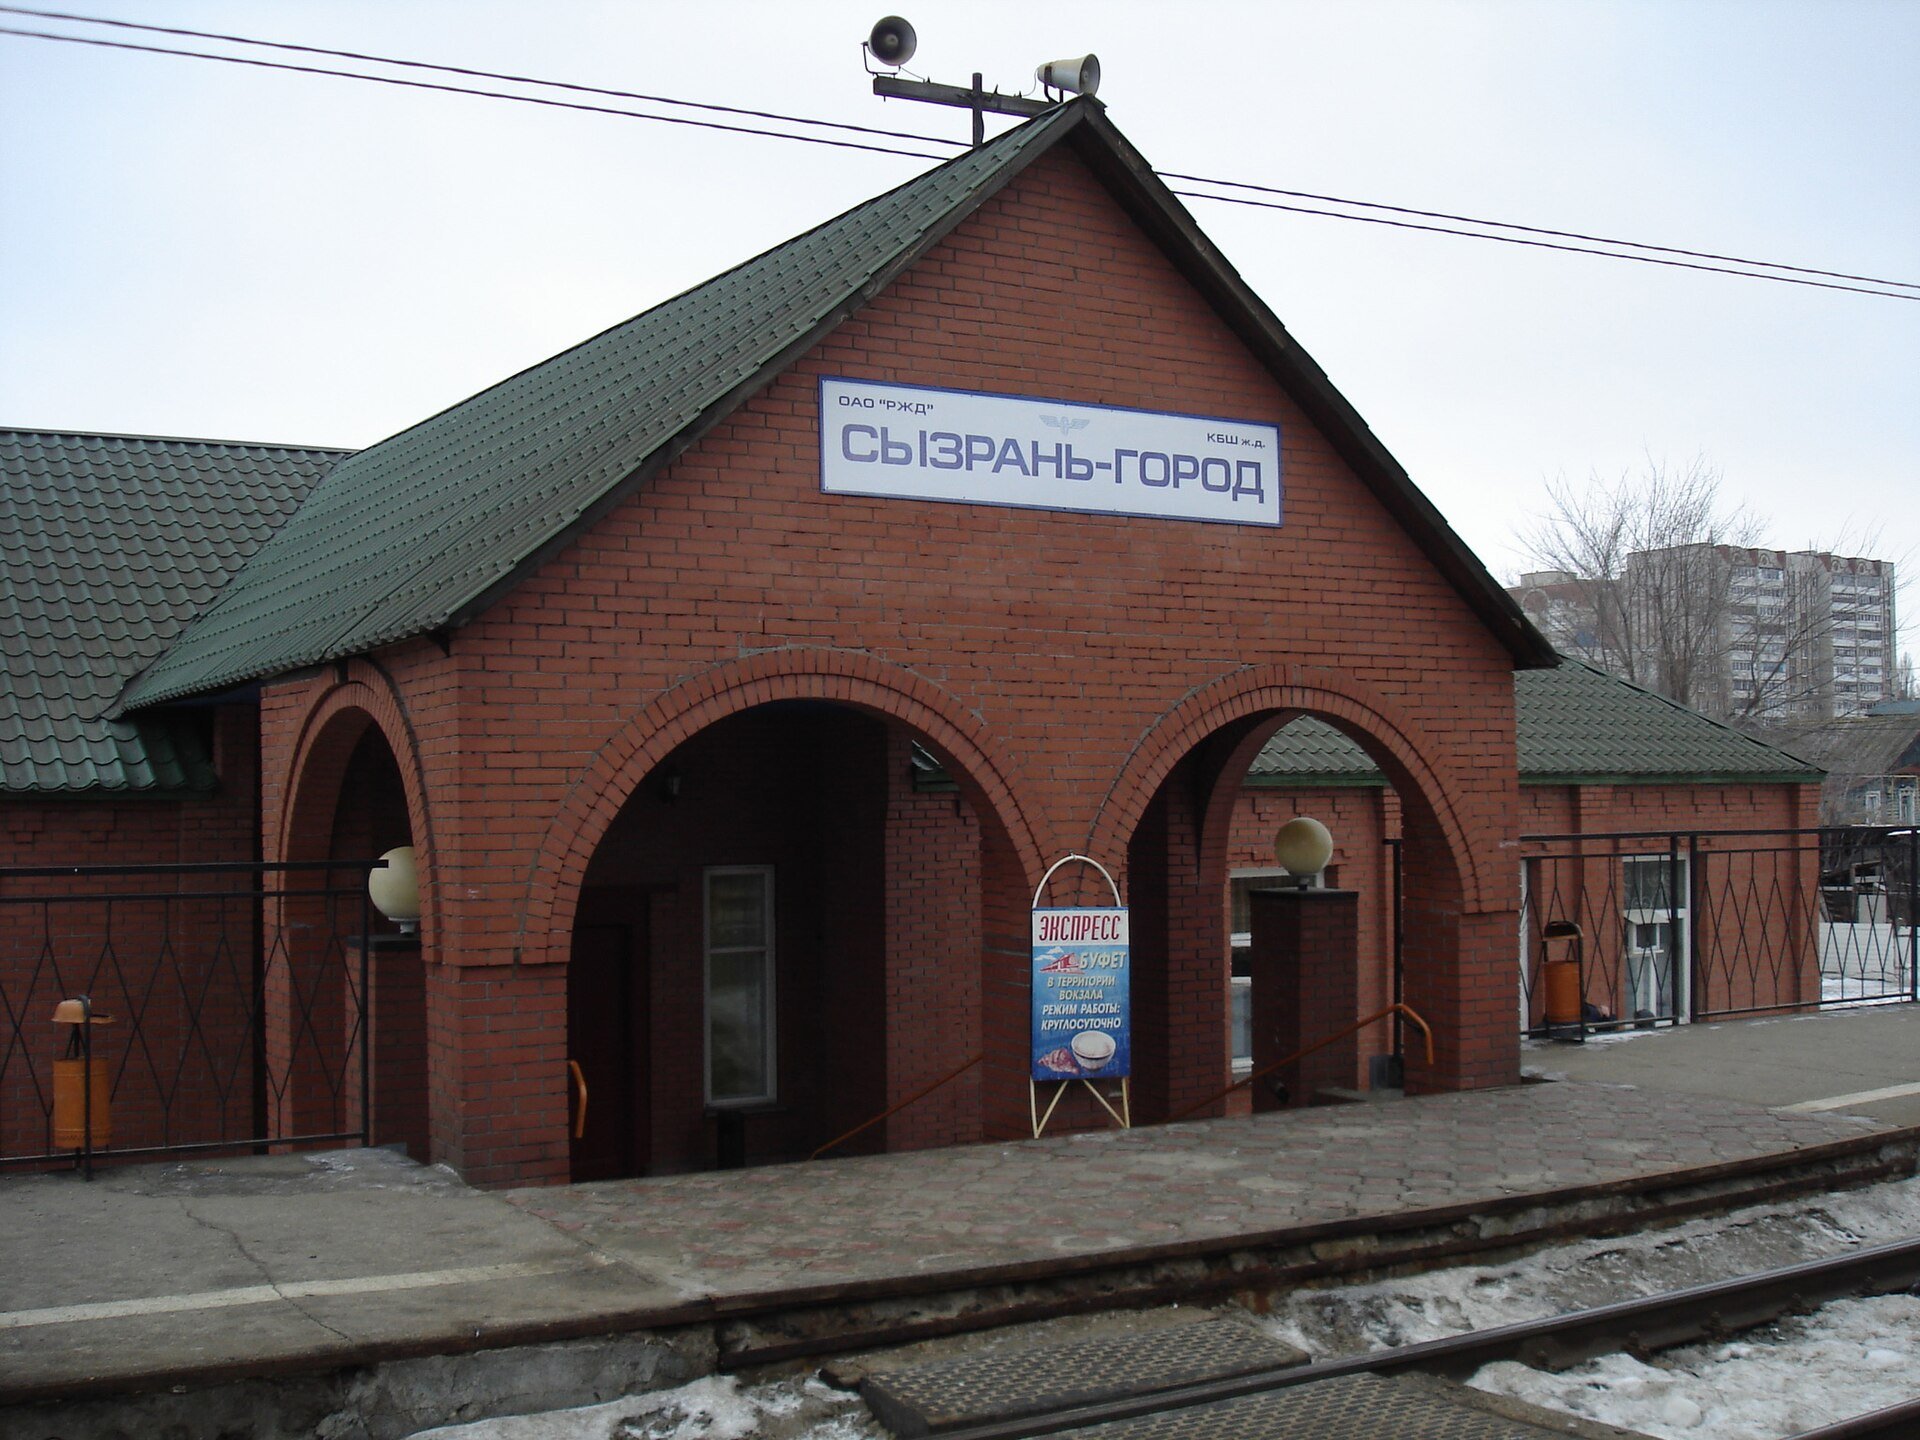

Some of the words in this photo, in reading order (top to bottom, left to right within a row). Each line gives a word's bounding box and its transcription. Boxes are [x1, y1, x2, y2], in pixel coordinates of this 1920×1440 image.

[838, 395, 875, 409] ОАО
[879, 399, 934, 416] "РЖД"
[1207, 432, 1238, 445] КБШ
[842, 424, 1264, 503] СЫЗРАНЬ-ГОРОД
[1039, 915, 1121, 941] ЭКСПРЕСС
[1079, 951, 1127, 970] БУФЕТ
[1047, 976, 1054, 988] В
[1057, 976, 1116, 988] ТЕРРИТОРИИ
[1059, 988, 1104, 1000] ВОКЗАЛА
[1042, 1003, 1078, 1016] РЕЖИМ
[1080, 1003, 1121, 1015] РАБОТЫ:
[1041, 1017, 1121, 1031] КРУГЛОСУТОЧНО
